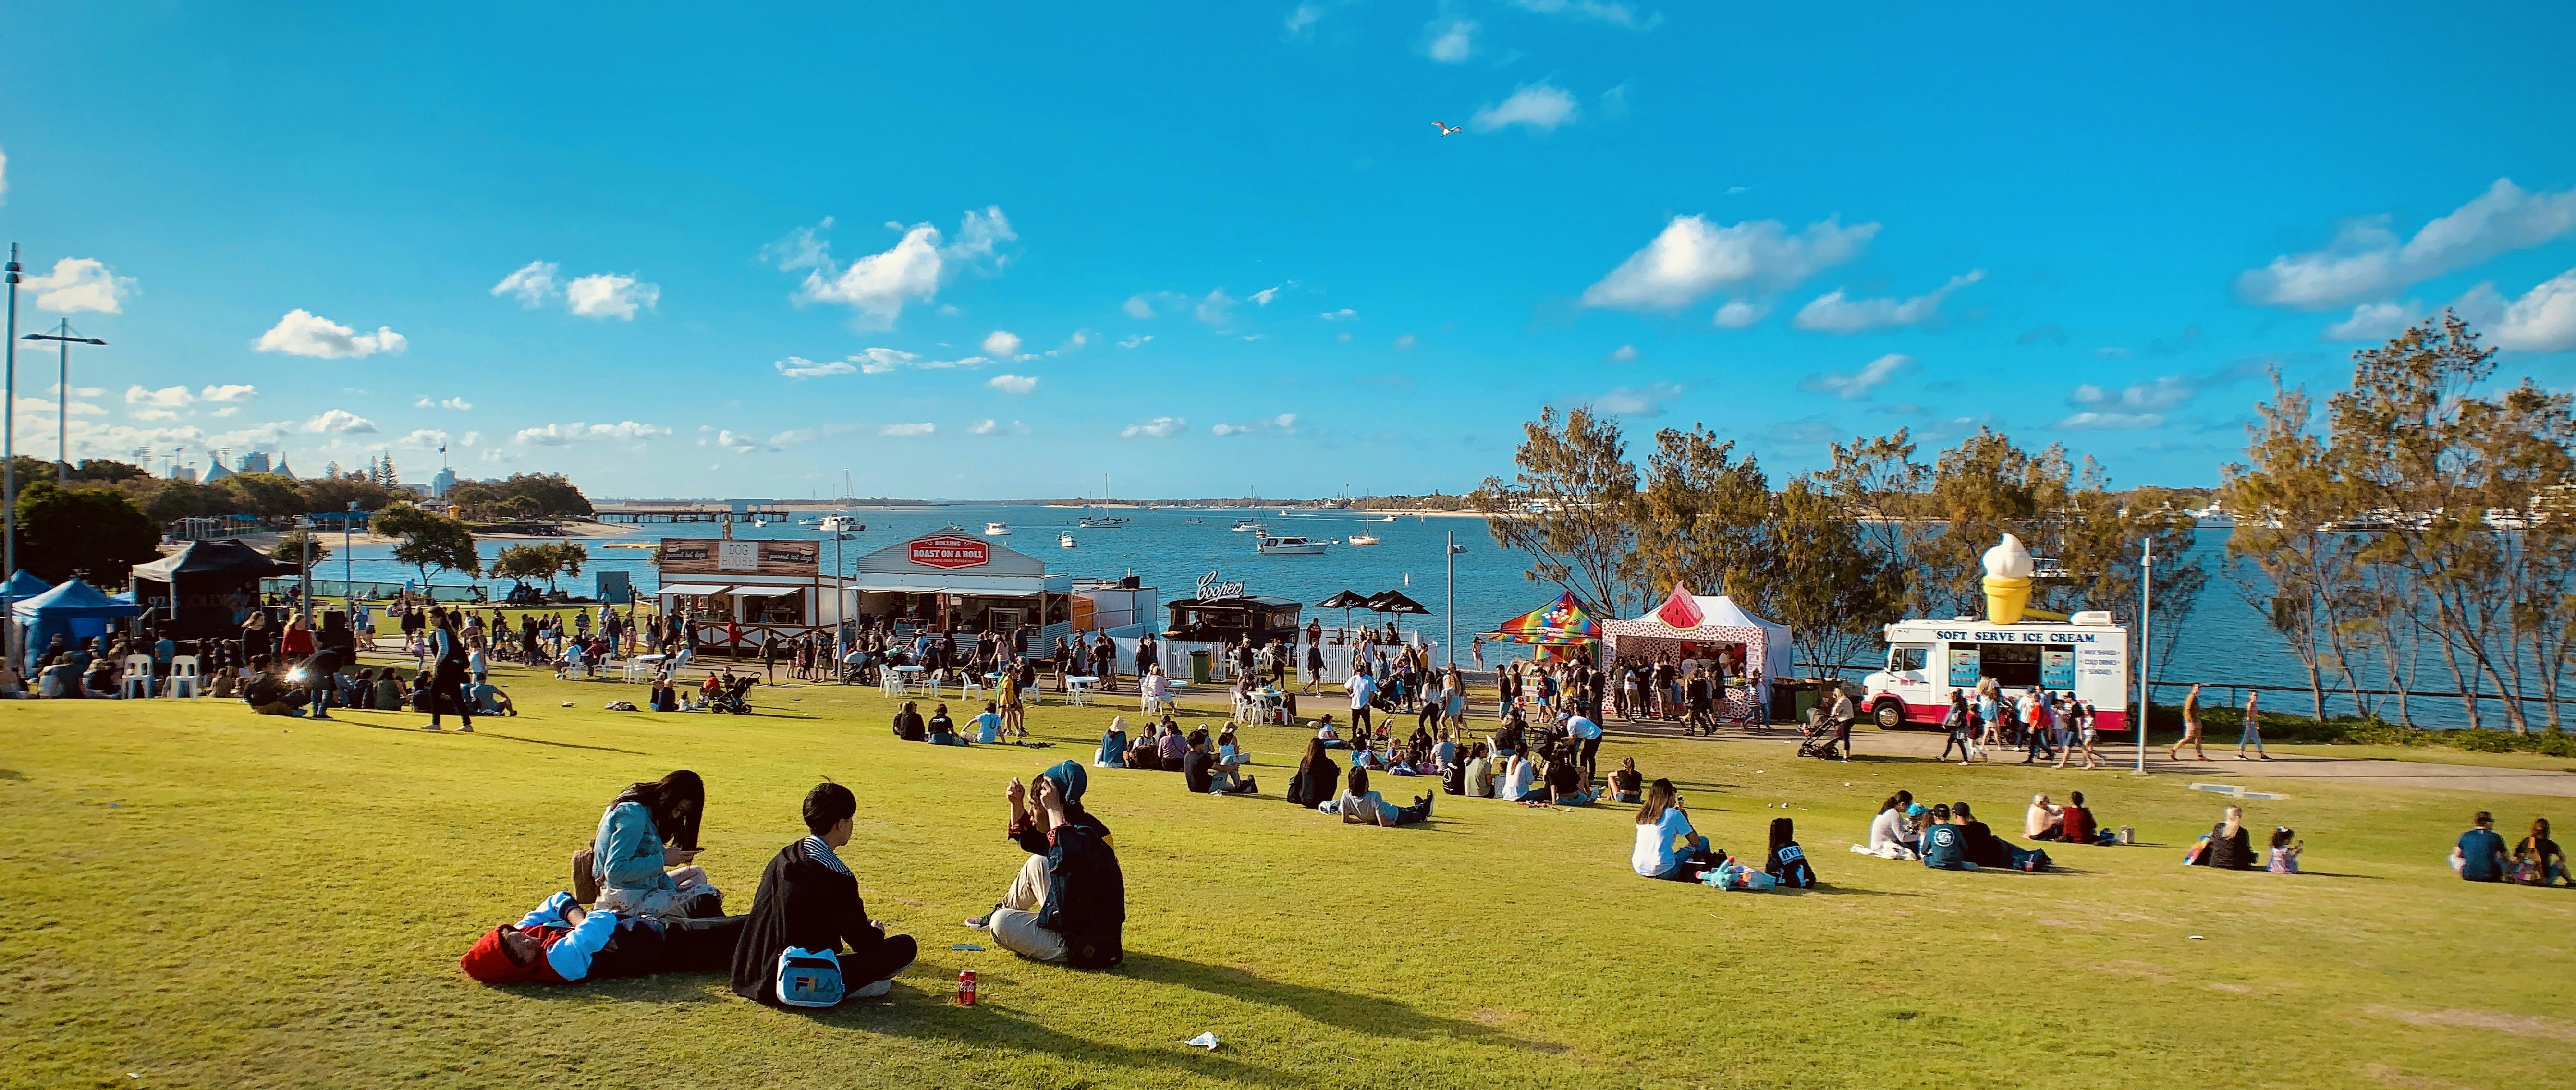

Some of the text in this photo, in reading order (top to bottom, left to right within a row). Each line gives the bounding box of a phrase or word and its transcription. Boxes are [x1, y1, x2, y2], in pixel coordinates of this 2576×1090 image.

[728, 545, 748, 555] DOG
[722, 556, 755, 566] HOUSE
[1196, 570, 1243, 602] Coopers
[1937, 631, 2096, 643] SOFT SERVE ICE CREAM
[795, 976, 836, 993] FILA
